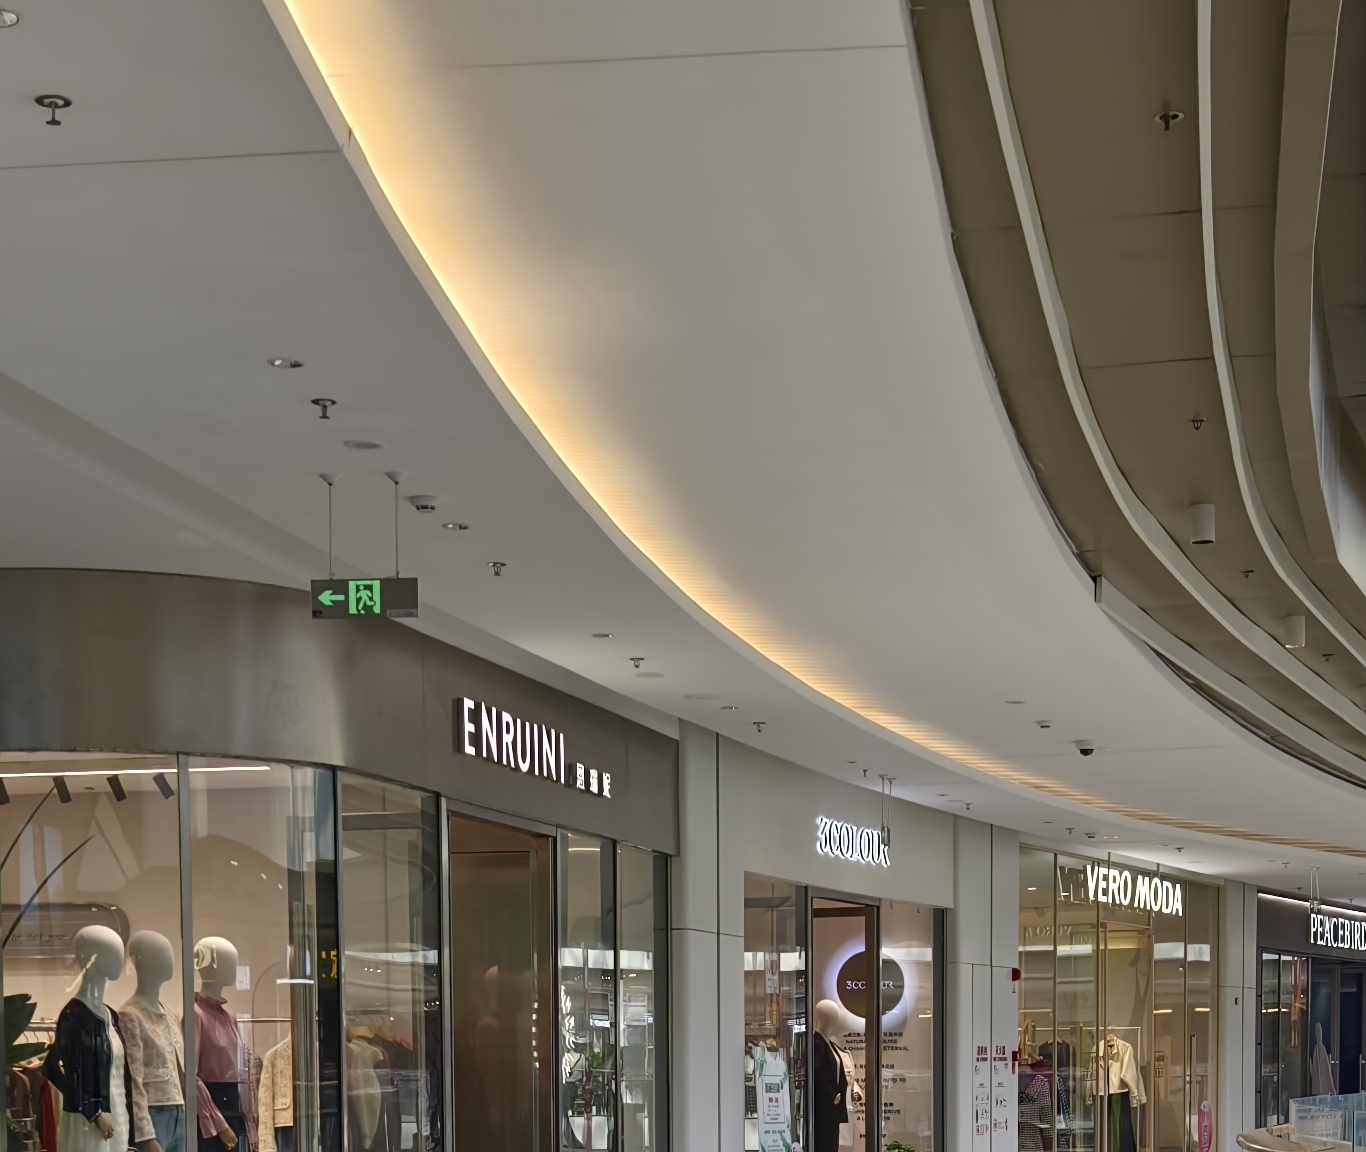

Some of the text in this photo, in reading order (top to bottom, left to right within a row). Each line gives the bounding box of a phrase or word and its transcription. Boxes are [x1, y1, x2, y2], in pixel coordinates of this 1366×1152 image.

[463, 697, 565, 784] ENRUINI
[1086, 864, 1183, 916] VERO MODA
